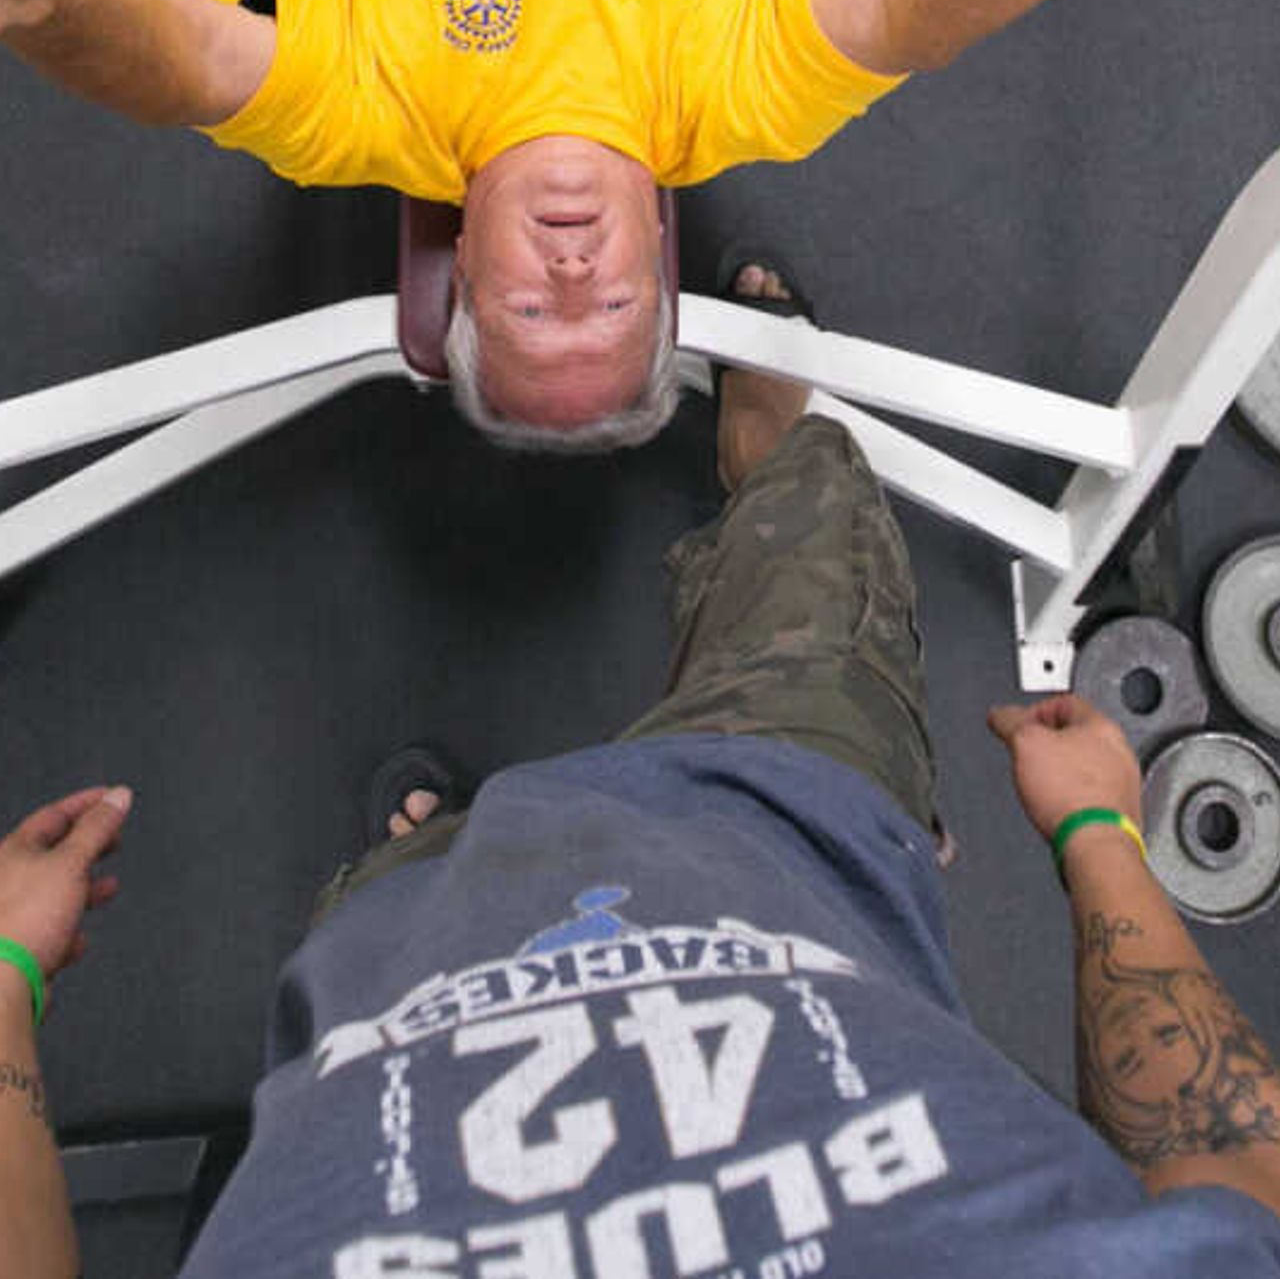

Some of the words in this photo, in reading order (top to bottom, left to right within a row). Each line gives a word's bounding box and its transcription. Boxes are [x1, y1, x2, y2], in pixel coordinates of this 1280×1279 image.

[393, 935, 769, 1034] BACKES
[453, 986, 776, 1204] 42
[332, 1091, 949, 1279] BLUES
[758, 1240, 827, 1279] OLD
